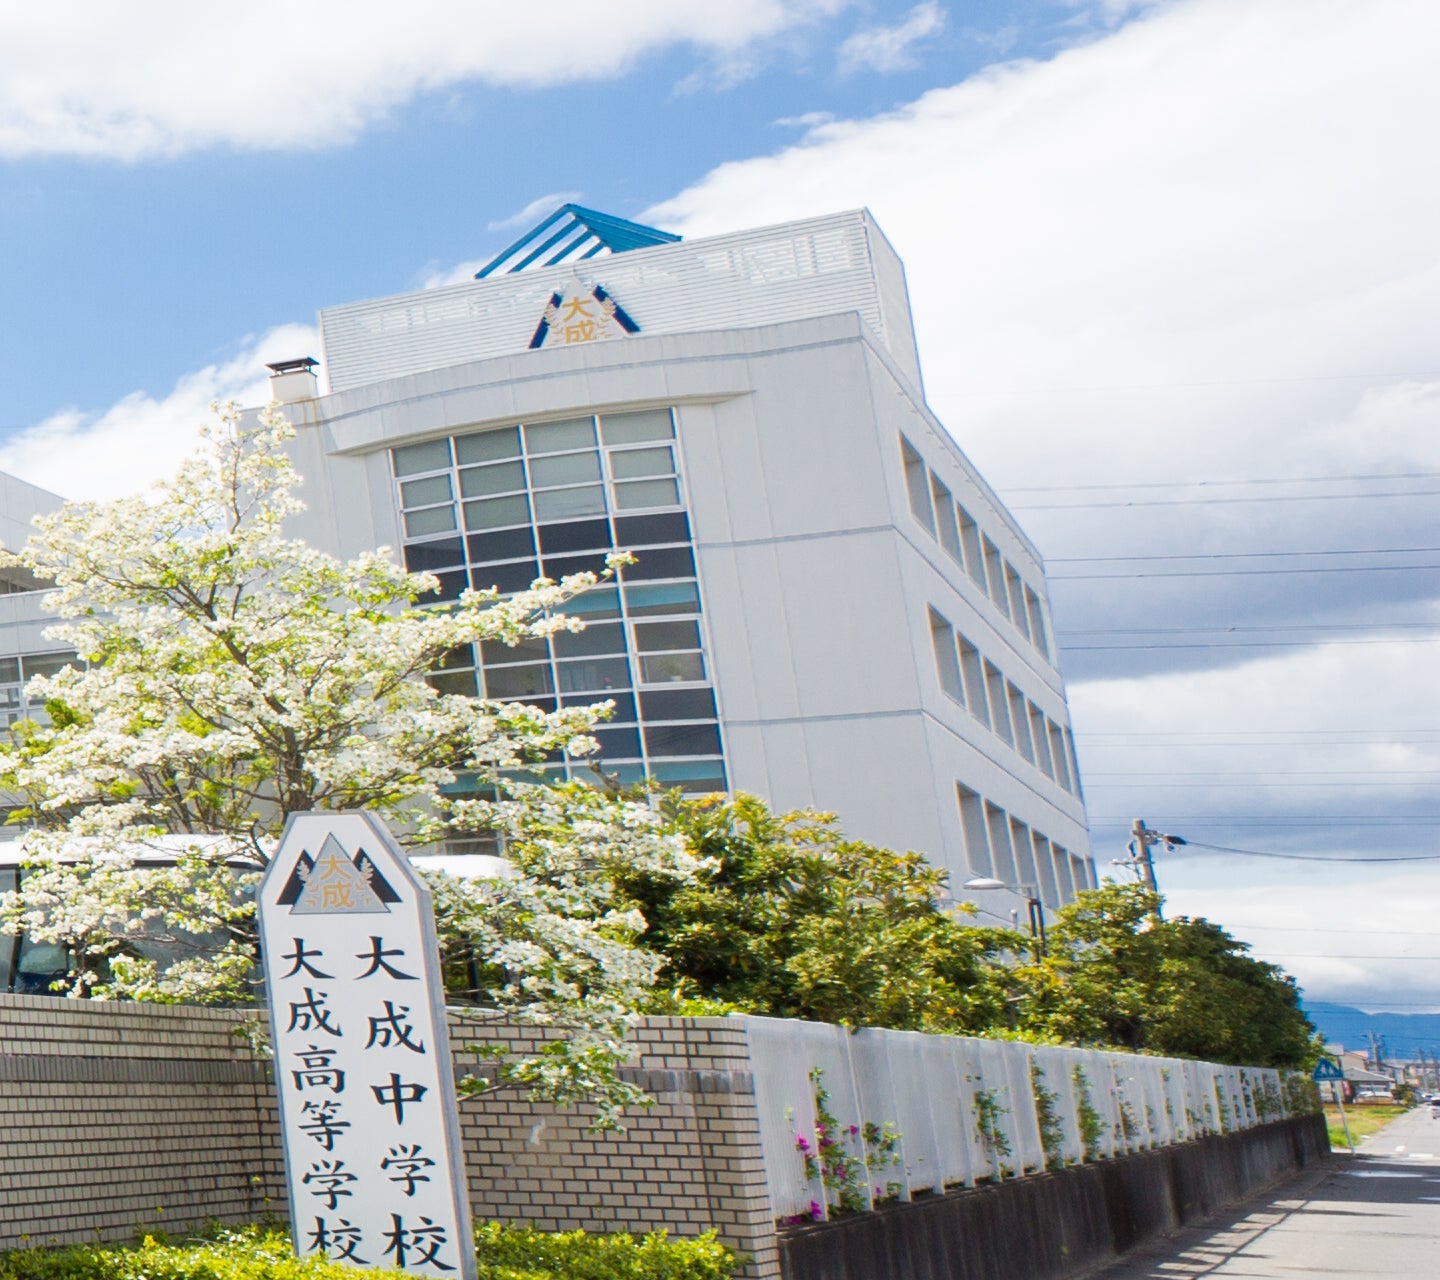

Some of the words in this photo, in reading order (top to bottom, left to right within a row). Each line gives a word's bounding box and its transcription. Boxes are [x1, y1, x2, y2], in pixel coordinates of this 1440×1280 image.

[561, 296, 597, 344] 大成
[319, 854, 356, 908] 大成
[280, 937, 371, 1264] 大成高等学校
[352, 936, 457, 1270] 大成中学校
